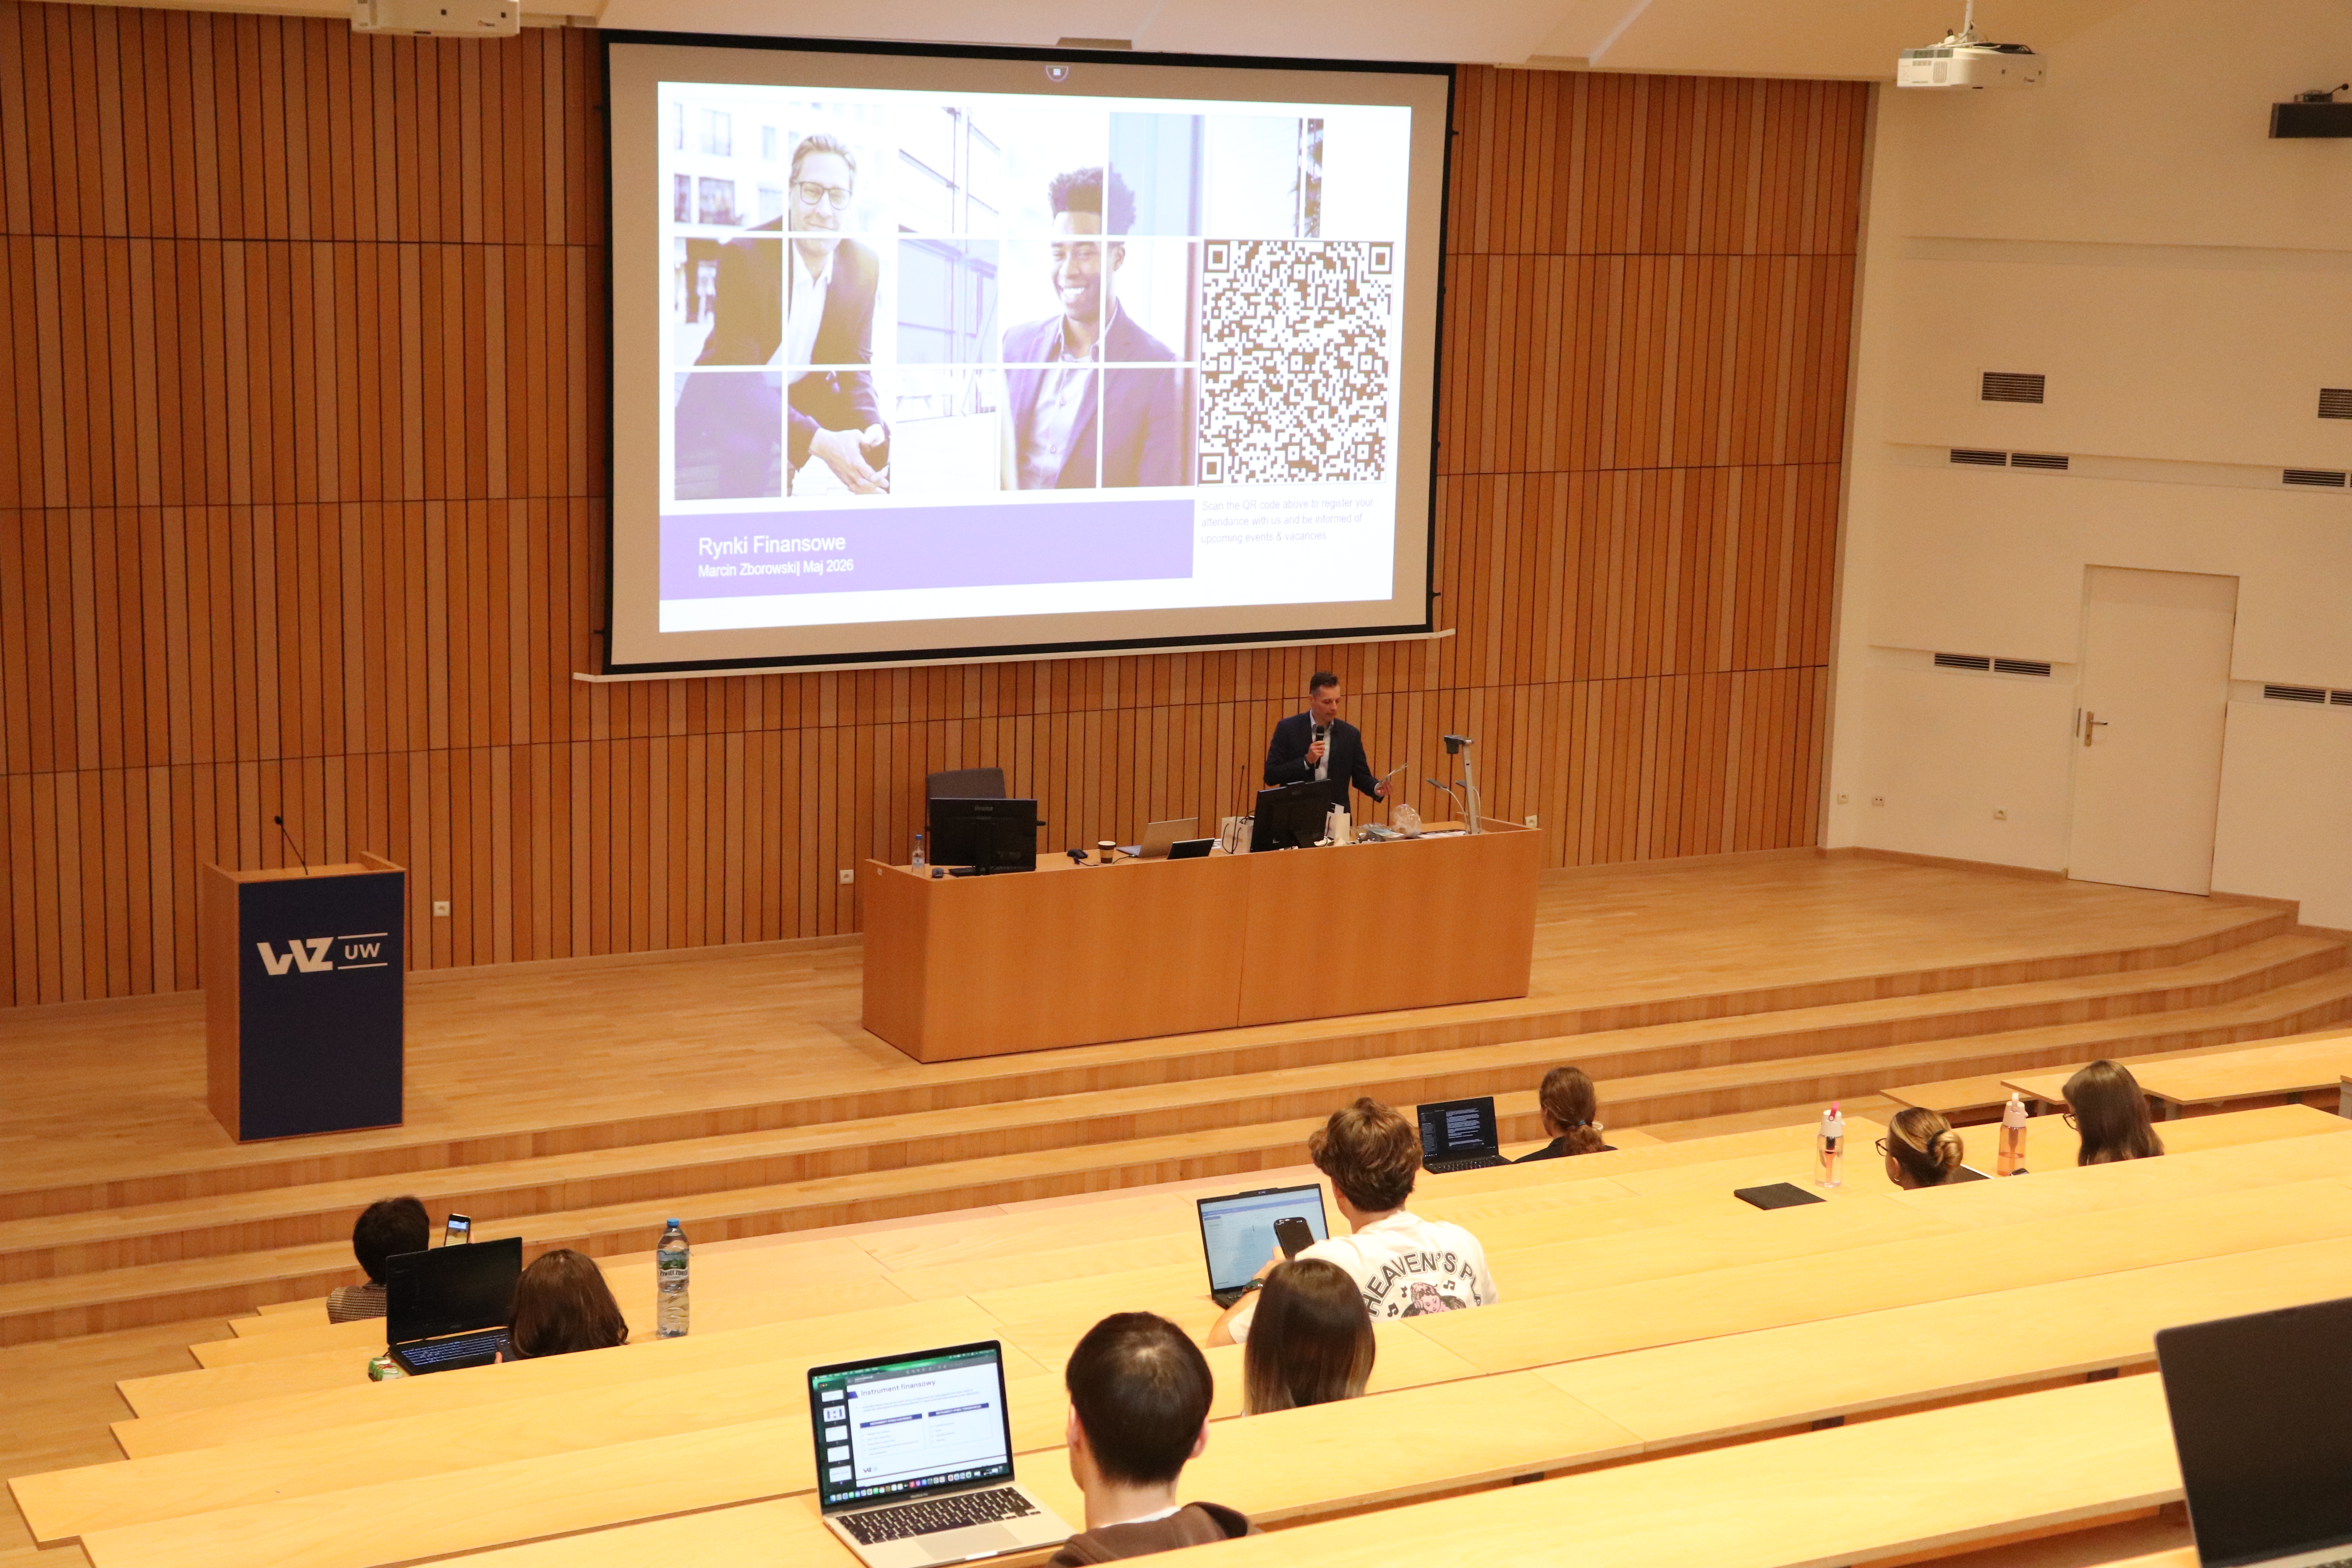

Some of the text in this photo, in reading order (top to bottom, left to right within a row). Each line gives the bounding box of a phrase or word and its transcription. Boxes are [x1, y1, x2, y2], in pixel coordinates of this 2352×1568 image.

[1202, 498, 1374, 510] Scan the QR code above to register your
[1201, 516, 1249, 527] attendance
[1252, 515, 1268, 525] with
[1284, 514, 1299, 524] and
[1302, 514, 1312, 524] be
[1315, 514, 1352, 523] informed
[1354, 513, 1362, 522] of
[1201, 531, 1327, 544] upcoming events & vacancies
[699, 535, 846, 559] Rynki Finansowe
[699, 563, 737, 577] Marcin
[803, 560, 823, 575] Maj
[826, 559, 854, 572] 2026
[256, 937, 381, 976] WZ UW
[1361, 1250, 1457, 1317] HEAVEN'S
[861, 1380, 936, 1396] Instrument finansowy
